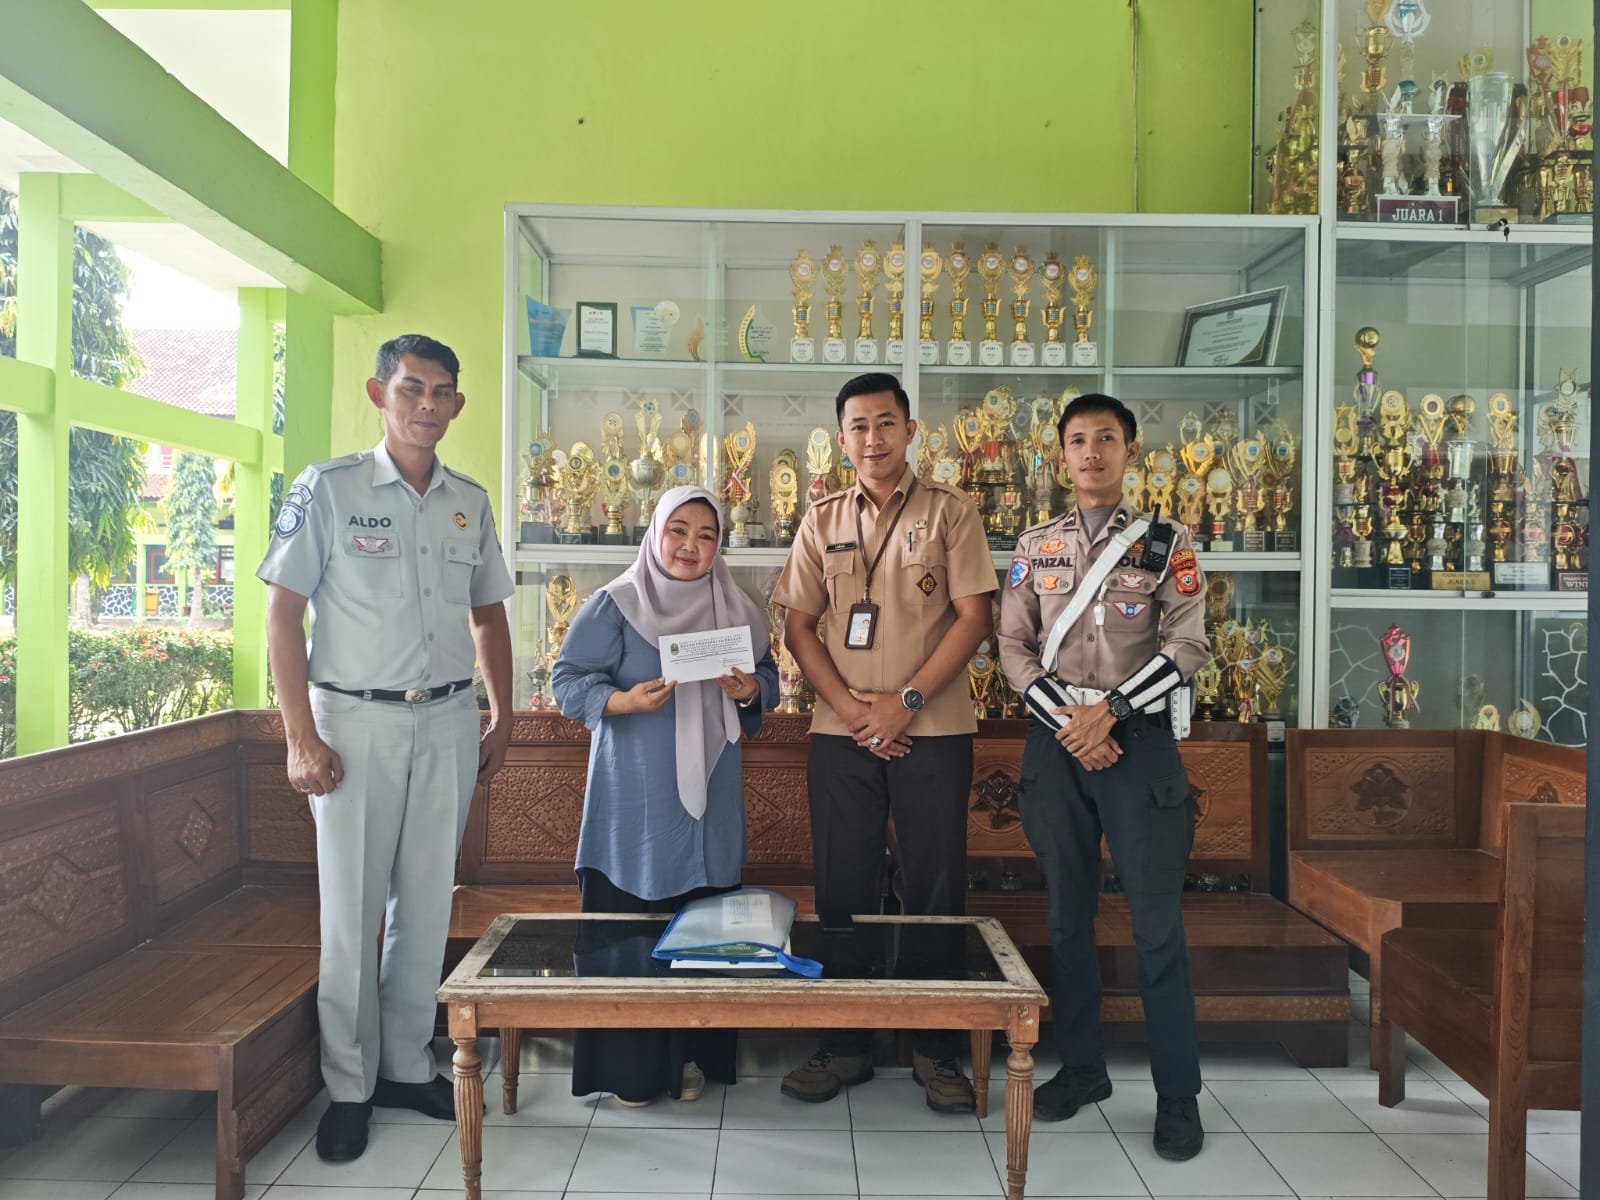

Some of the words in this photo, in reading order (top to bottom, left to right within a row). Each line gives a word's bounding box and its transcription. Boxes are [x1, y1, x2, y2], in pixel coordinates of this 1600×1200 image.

[1392, 208, 1435, 221] JUARA
[1438, 209, 1443, 222] 1
[348, 515, 392, 528] ALDO
[1031, 556, 1073, 569] FAIZAL
